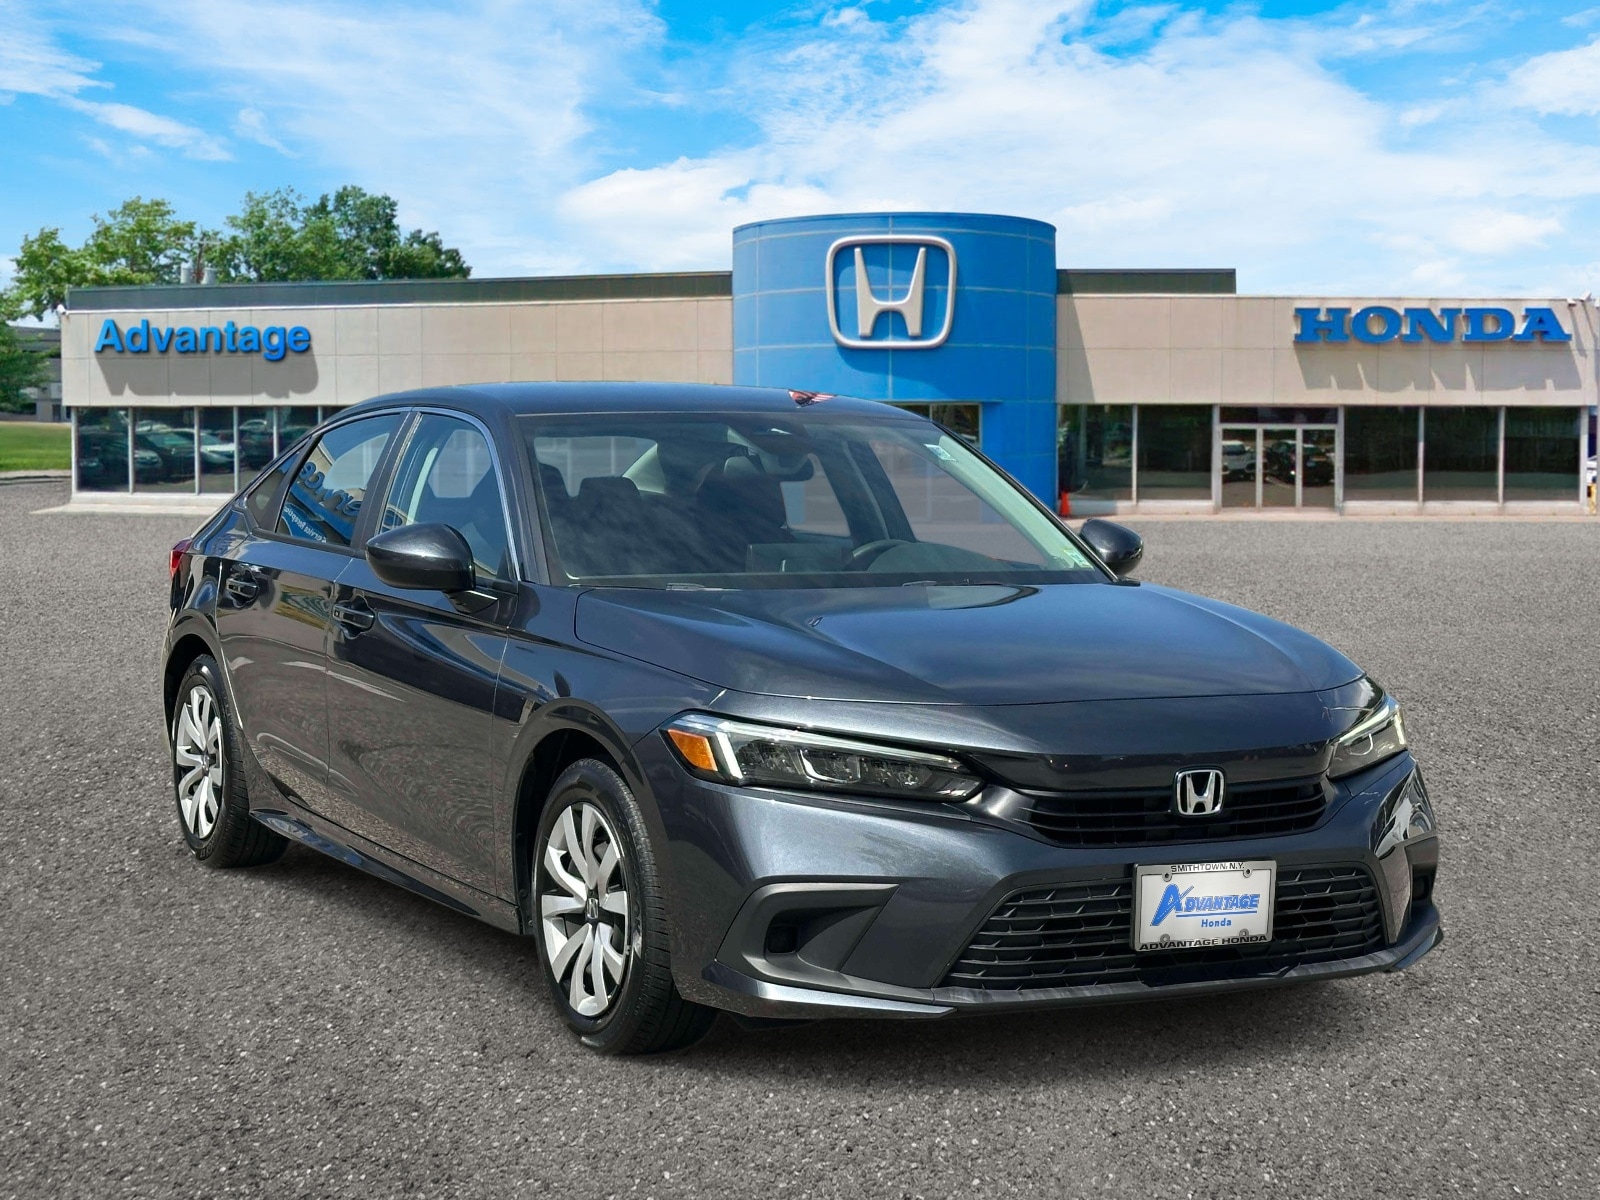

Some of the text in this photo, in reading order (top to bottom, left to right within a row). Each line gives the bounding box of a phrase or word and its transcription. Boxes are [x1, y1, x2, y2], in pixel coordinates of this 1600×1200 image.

[94, 318, 311, 361] Advantage
[1294, 306, 1572, 343] HONDA
[1150, 883, 1261, 926] ADVANTAGE
[1201, 918, 1232, 928] Honda
[1139, 935, 1268, 951] ADVANTAGE HONDA
